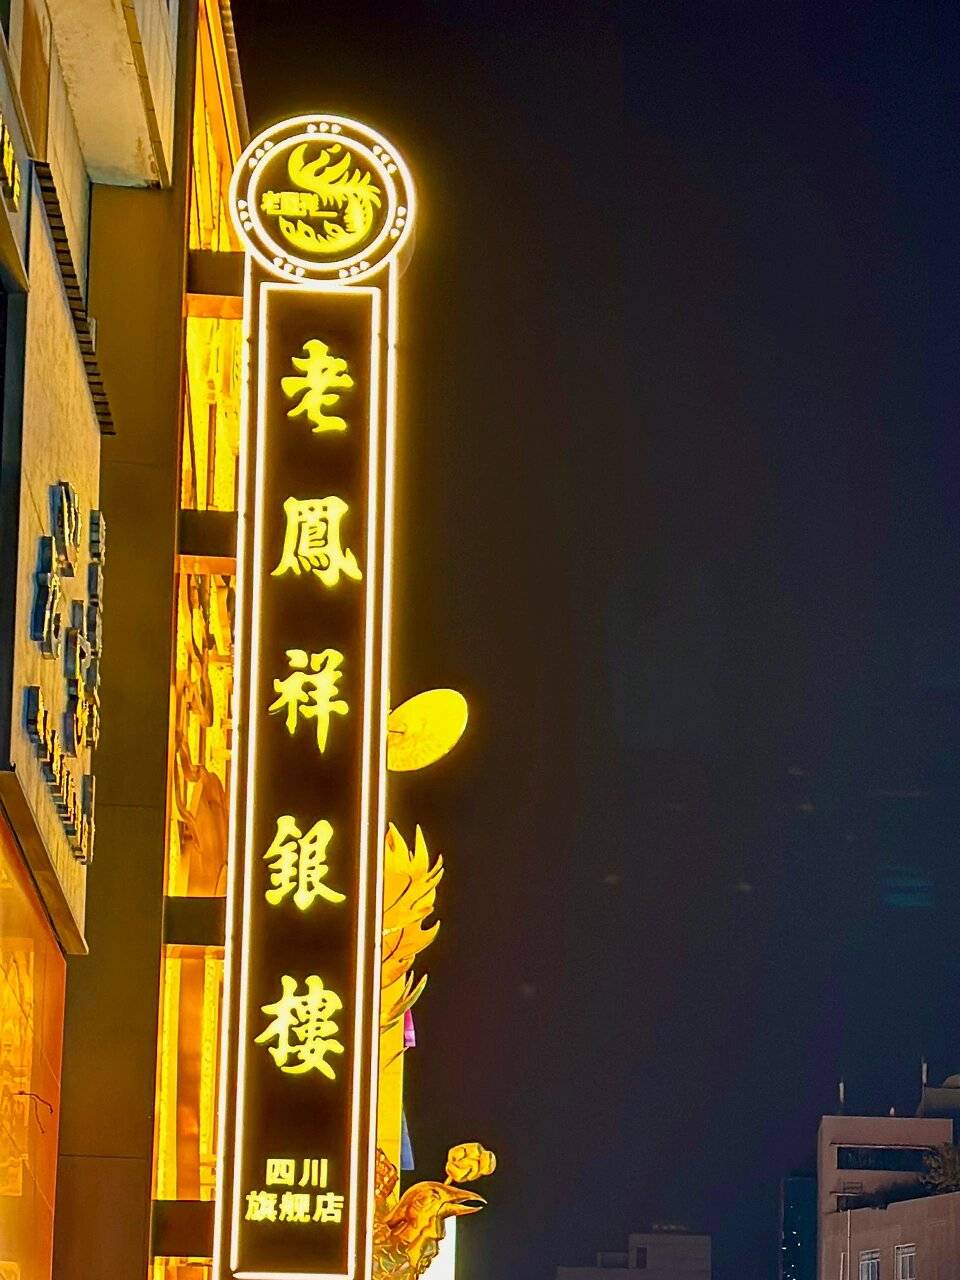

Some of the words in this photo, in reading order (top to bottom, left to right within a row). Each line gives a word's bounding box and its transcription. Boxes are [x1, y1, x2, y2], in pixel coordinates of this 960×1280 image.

[254, 338, 363, 1081] 老鳳祥銀樓
[265, 1158, 328, 1188] 四川
[244, 1190, 345, 1223] 旗舰店
